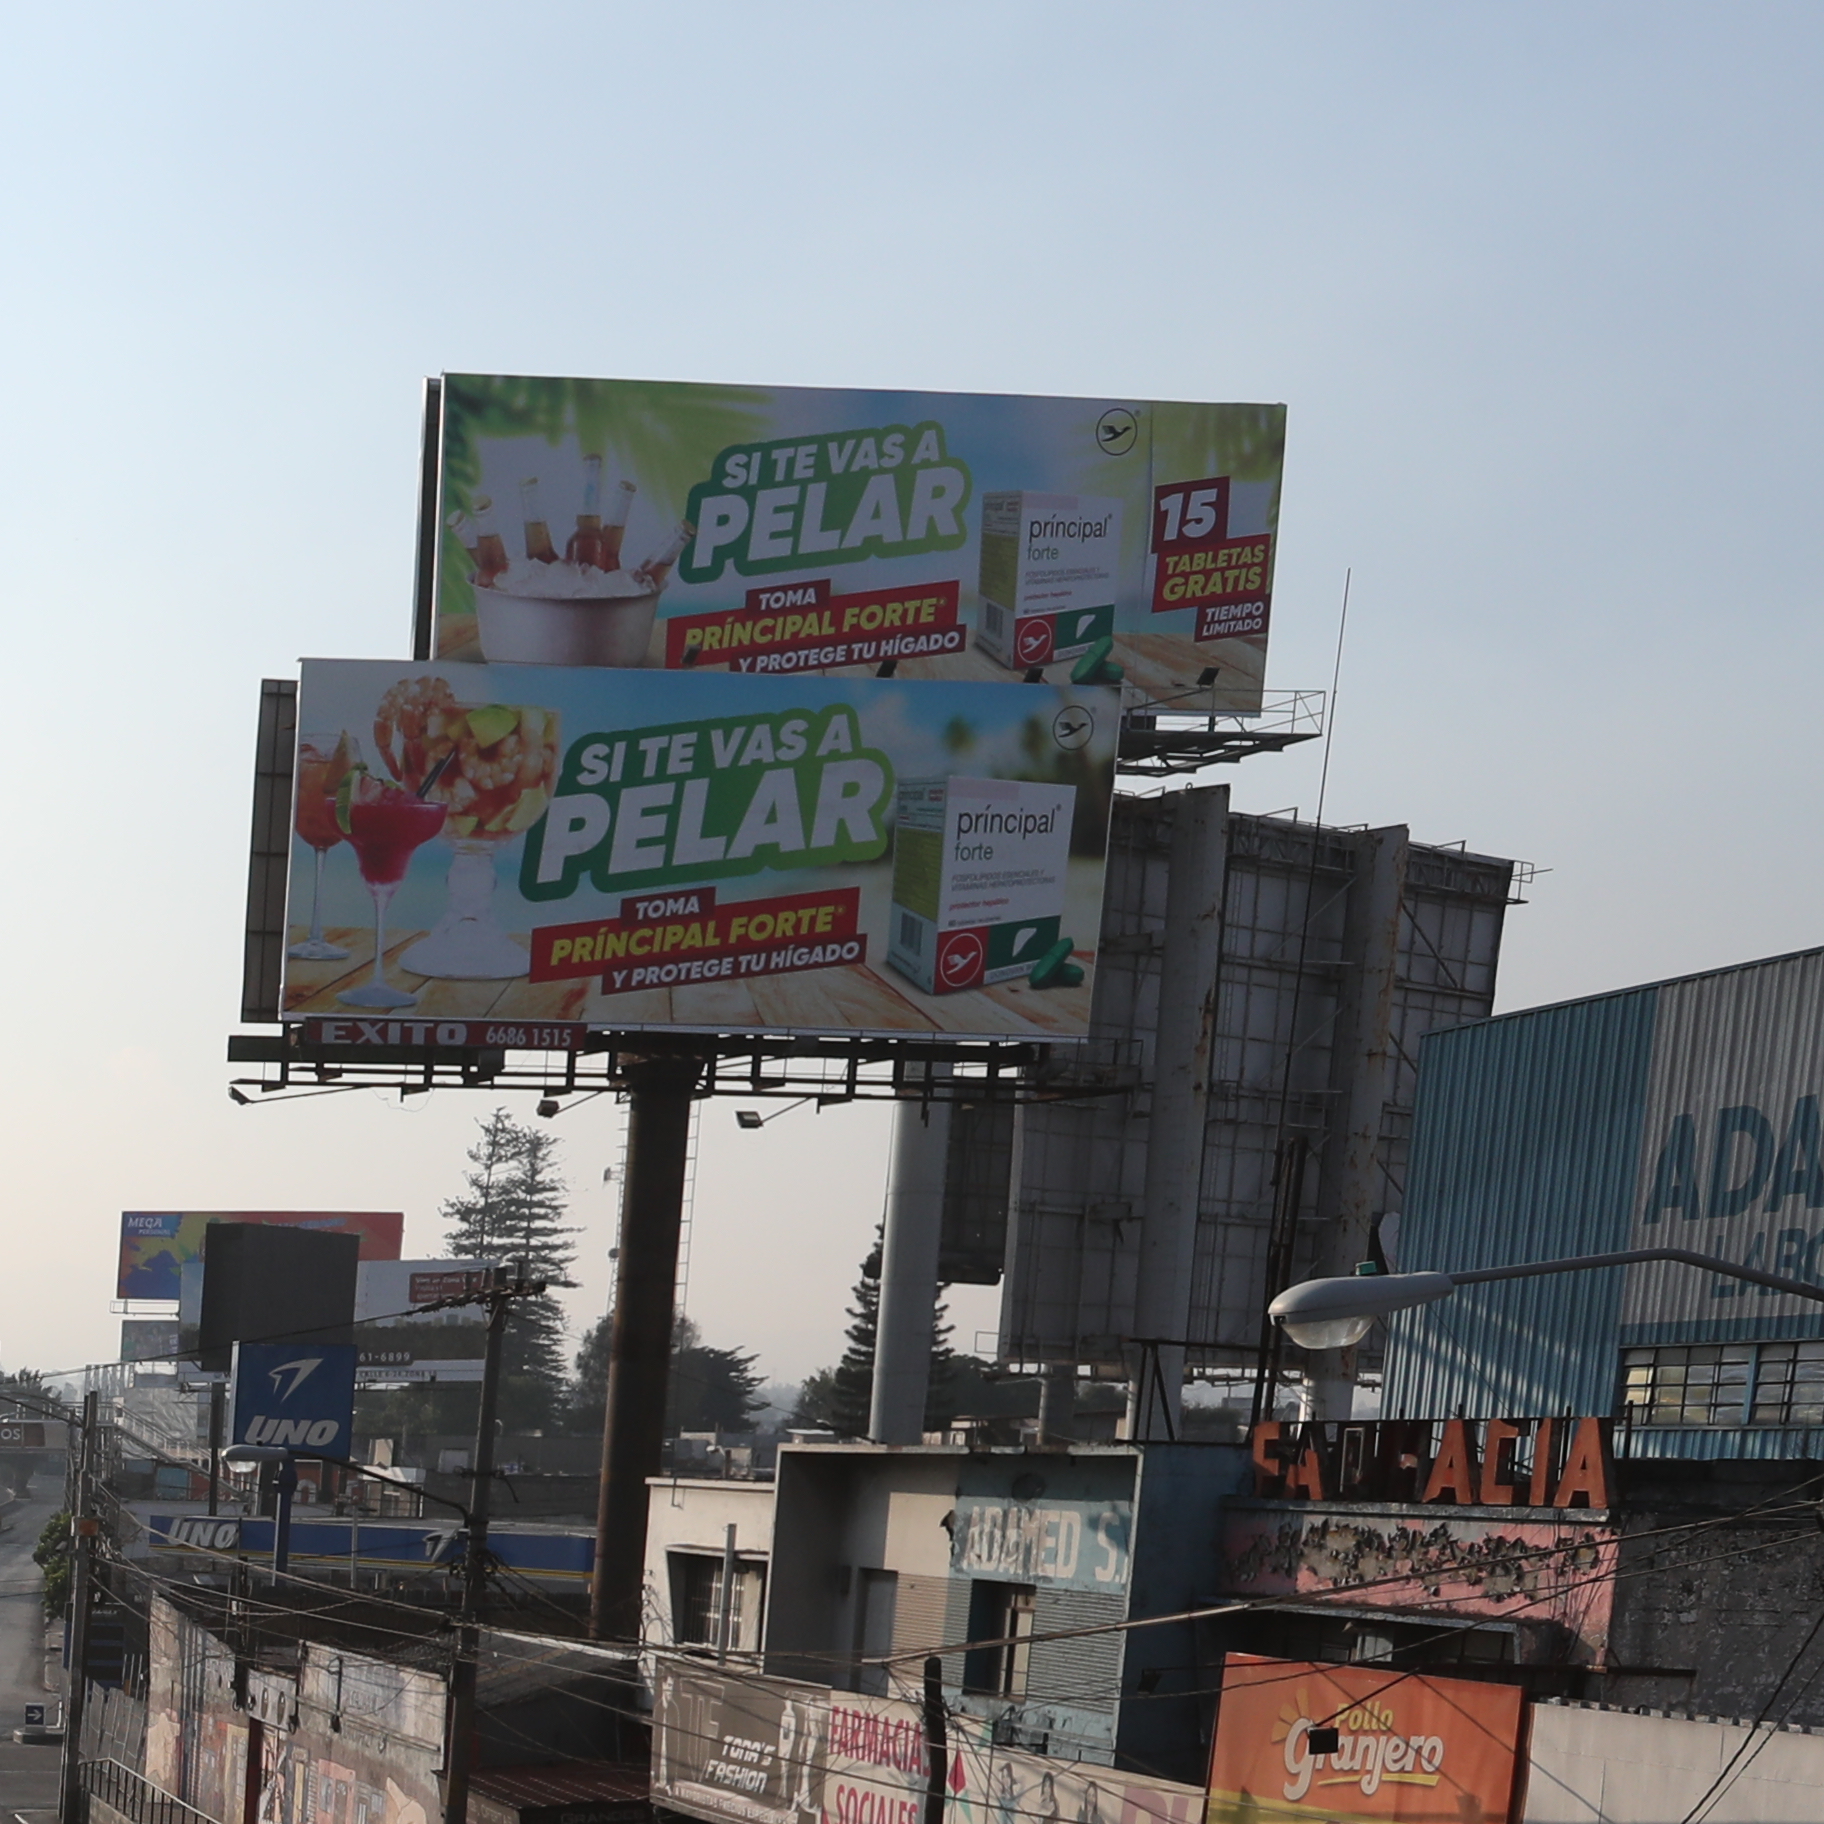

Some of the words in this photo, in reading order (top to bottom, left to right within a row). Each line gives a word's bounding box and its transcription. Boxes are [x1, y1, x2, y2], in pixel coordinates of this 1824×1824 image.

[722, 452, 761, 488] SI
[771, 444, 817, 482] TE
[827, 433, 906, 475] VAS
[911, 430, 940, 464] A
[692, 466, 965, 569] PELAR
[1159, 489, 1217, 541] 15
[1027, 544, 1059, 561] forte
[1166, 544, 1265, 575] TABLETAS
[759, 588, 816, 611] TOMA
[1162, 567, 1262, 601] GRATIS
[1202, 619, 1263, 636] LIMITADO
[1205, 601, 1265, 621] TIEMPO
[684, 611, 837, 651] PRÍNCIPAL
[738, 657, 754, 672] Y
[756, 643, 847, 671] PROTEGE
[851, 641, 874, 659] TU
[880, 631, 960, 657] HÍGADO
[577, 741, 627, 785] SI
[638, 732, 697, 777] TE
[710, 719, 809, 769] VAS
[816, 714, 852, 756] A
[536, 759, 884, 884] PELAR
[954, 842, 993, 861] forte
[636, 896, 700, 920] TOMA
[550, 921, 721, 966] PRÍNCIPAL
[612, 971, 629, 988] Y
[631, 956, 733, 986] PROTEGE
[737, 953, 764, 973] TU
[770, 941, 860, 970] HÍGADO
[321, 1022, 468, 1045] EXITO
[486, 1026, 526, 1046] 6686
[532, 1028, 572, 1046] 1515
[244, 1415, 339, 1446] UNO
[167, 1516, 240, 1549] UNO
[830, 1706, 932, 1777] FARMACIA
[1334, 1700, 1394, 1751] Pollo
[705, 1759, 768, 1793] FASHION
